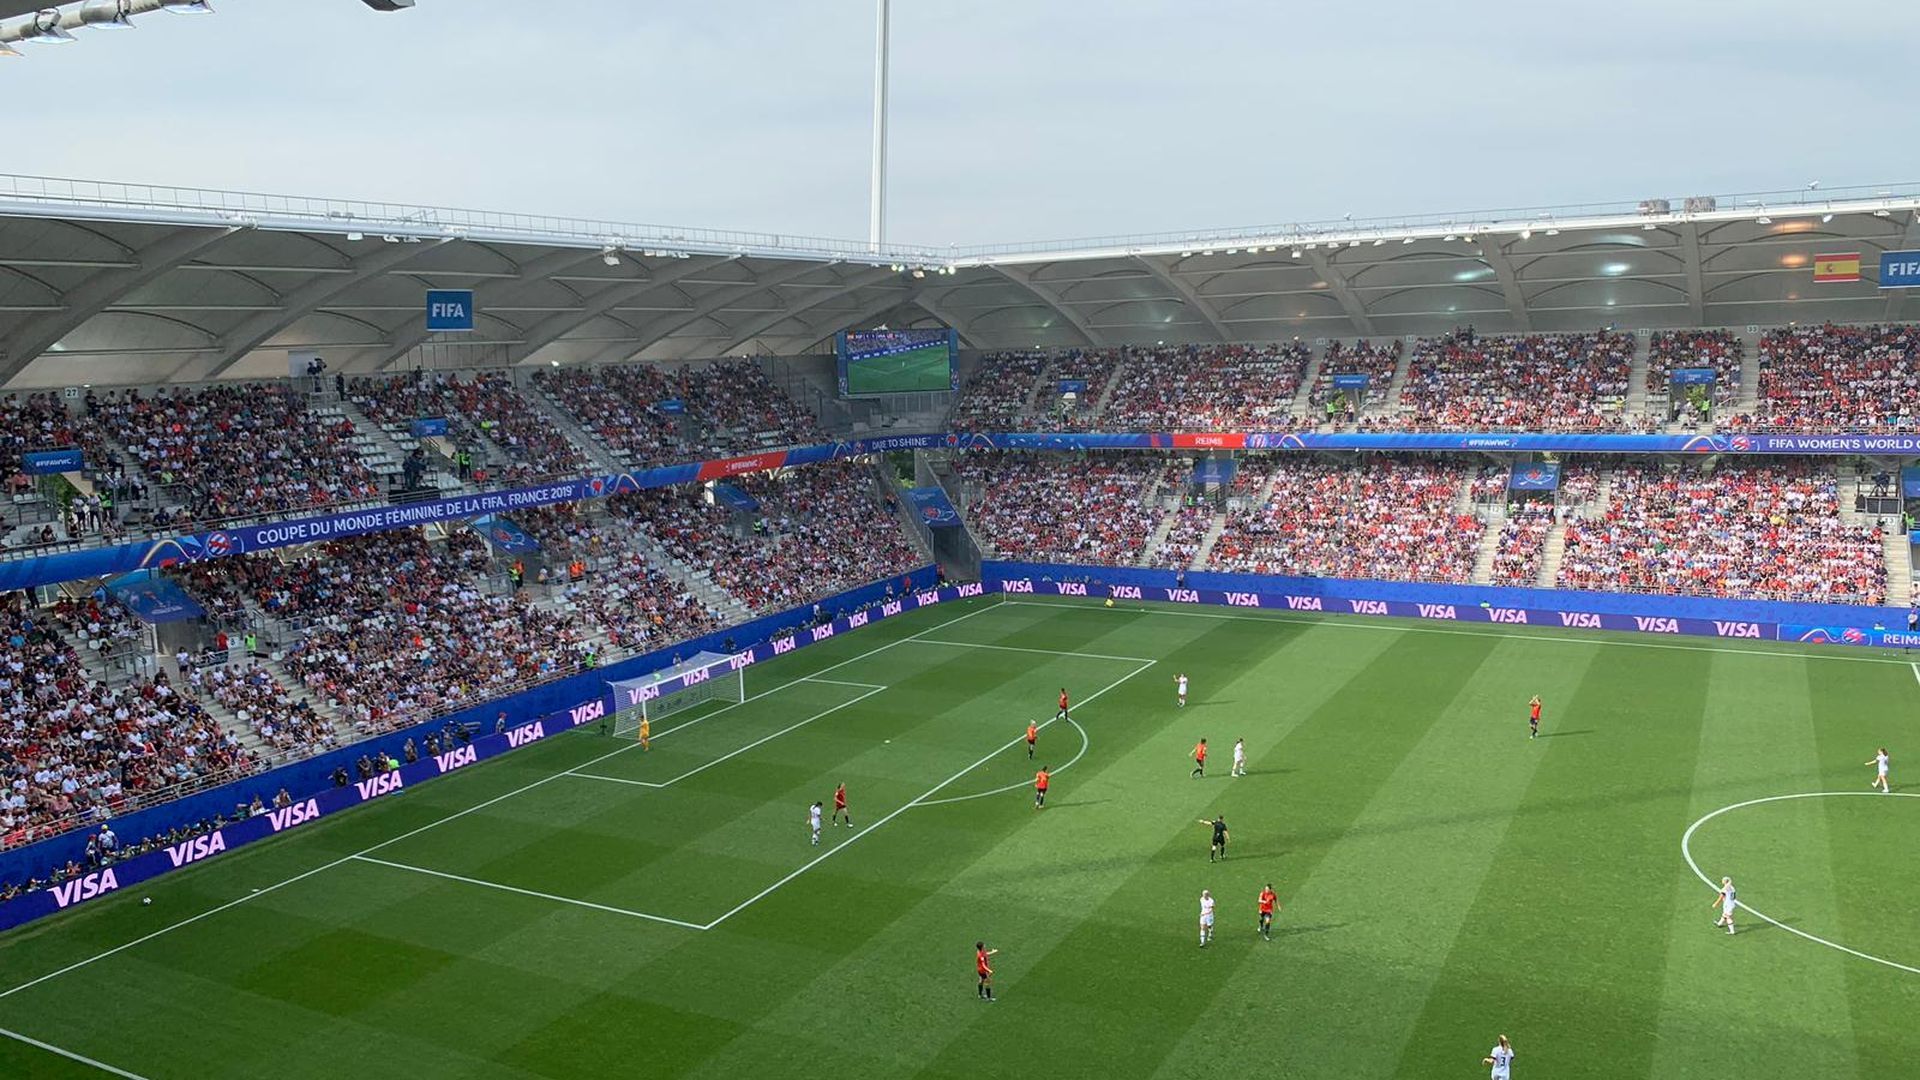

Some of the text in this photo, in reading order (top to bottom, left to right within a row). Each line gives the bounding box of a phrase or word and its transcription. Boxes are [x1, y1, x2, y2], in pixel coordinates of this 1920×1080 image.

[432, 303, 465, 318] FIFA
[888, 439, 898, 448] TO
[899, 437, 928, 448] SHINE
[1769, 438, 1794, 449] FIFA
[1798, 438, 1861, 449] WOMEN'S
[1865, 438, 1913, 449] WORLD
[257, 524, 307, 544] COUPE
[310, 519, 330, 535] DU
[334, 513, 383, 532] MONDE
[446, 501, 461, 514] DE
[464, 499, 480, 512] LA
[508, 489, 549, 506] FRANCE
[551, 486, 573, 500] 2019
[957, 582, 983, 598] VISA
[1002, 580, 1034, 594] VISA
[1056, 582, 1087, 596] VISA
[1112, 586, 1142, 600] VISA
[1166, 588, 1199, 603] VISA
[917, 589, 939, 606] VISA
[1224, 591, 1259, 607] VISA
[1285, 595, 1322, 611] VISA
[882, 600, 902, 616] VISA
[1350, 600, 1388, 615] VISA
[1417, 604, 1456, 620] VISA
[1487, 607, 1528, 625] VISA
[848, 611, 869, 628] VISA
[1558, 611, 1602, 629] VISA
[1633, 617, 1678, 634] VISA
[811, 623, 833, 641] VISA
[1713, 620, 1760, 638] VISA
[772, 637, 795, 654] VISA
[1883, 633, 1920, 645] REIM
[731, 649, 755, 670] VISA
[682, 668, 709, 687] VISA
[628, 685, 659, 705] VISA
[570, 701, 604, 725] VISA
[506, 721, 545, 748] VISA
[434, 744, 476, 772] VISA
[354, 769, 403, 800] VISA
[266, 799, 319, 831] VISA
[164, 831, 225, 866] VISA
[48, 868, 118, 907] VISA
[1500, 1056, 1506, 1067] 3
